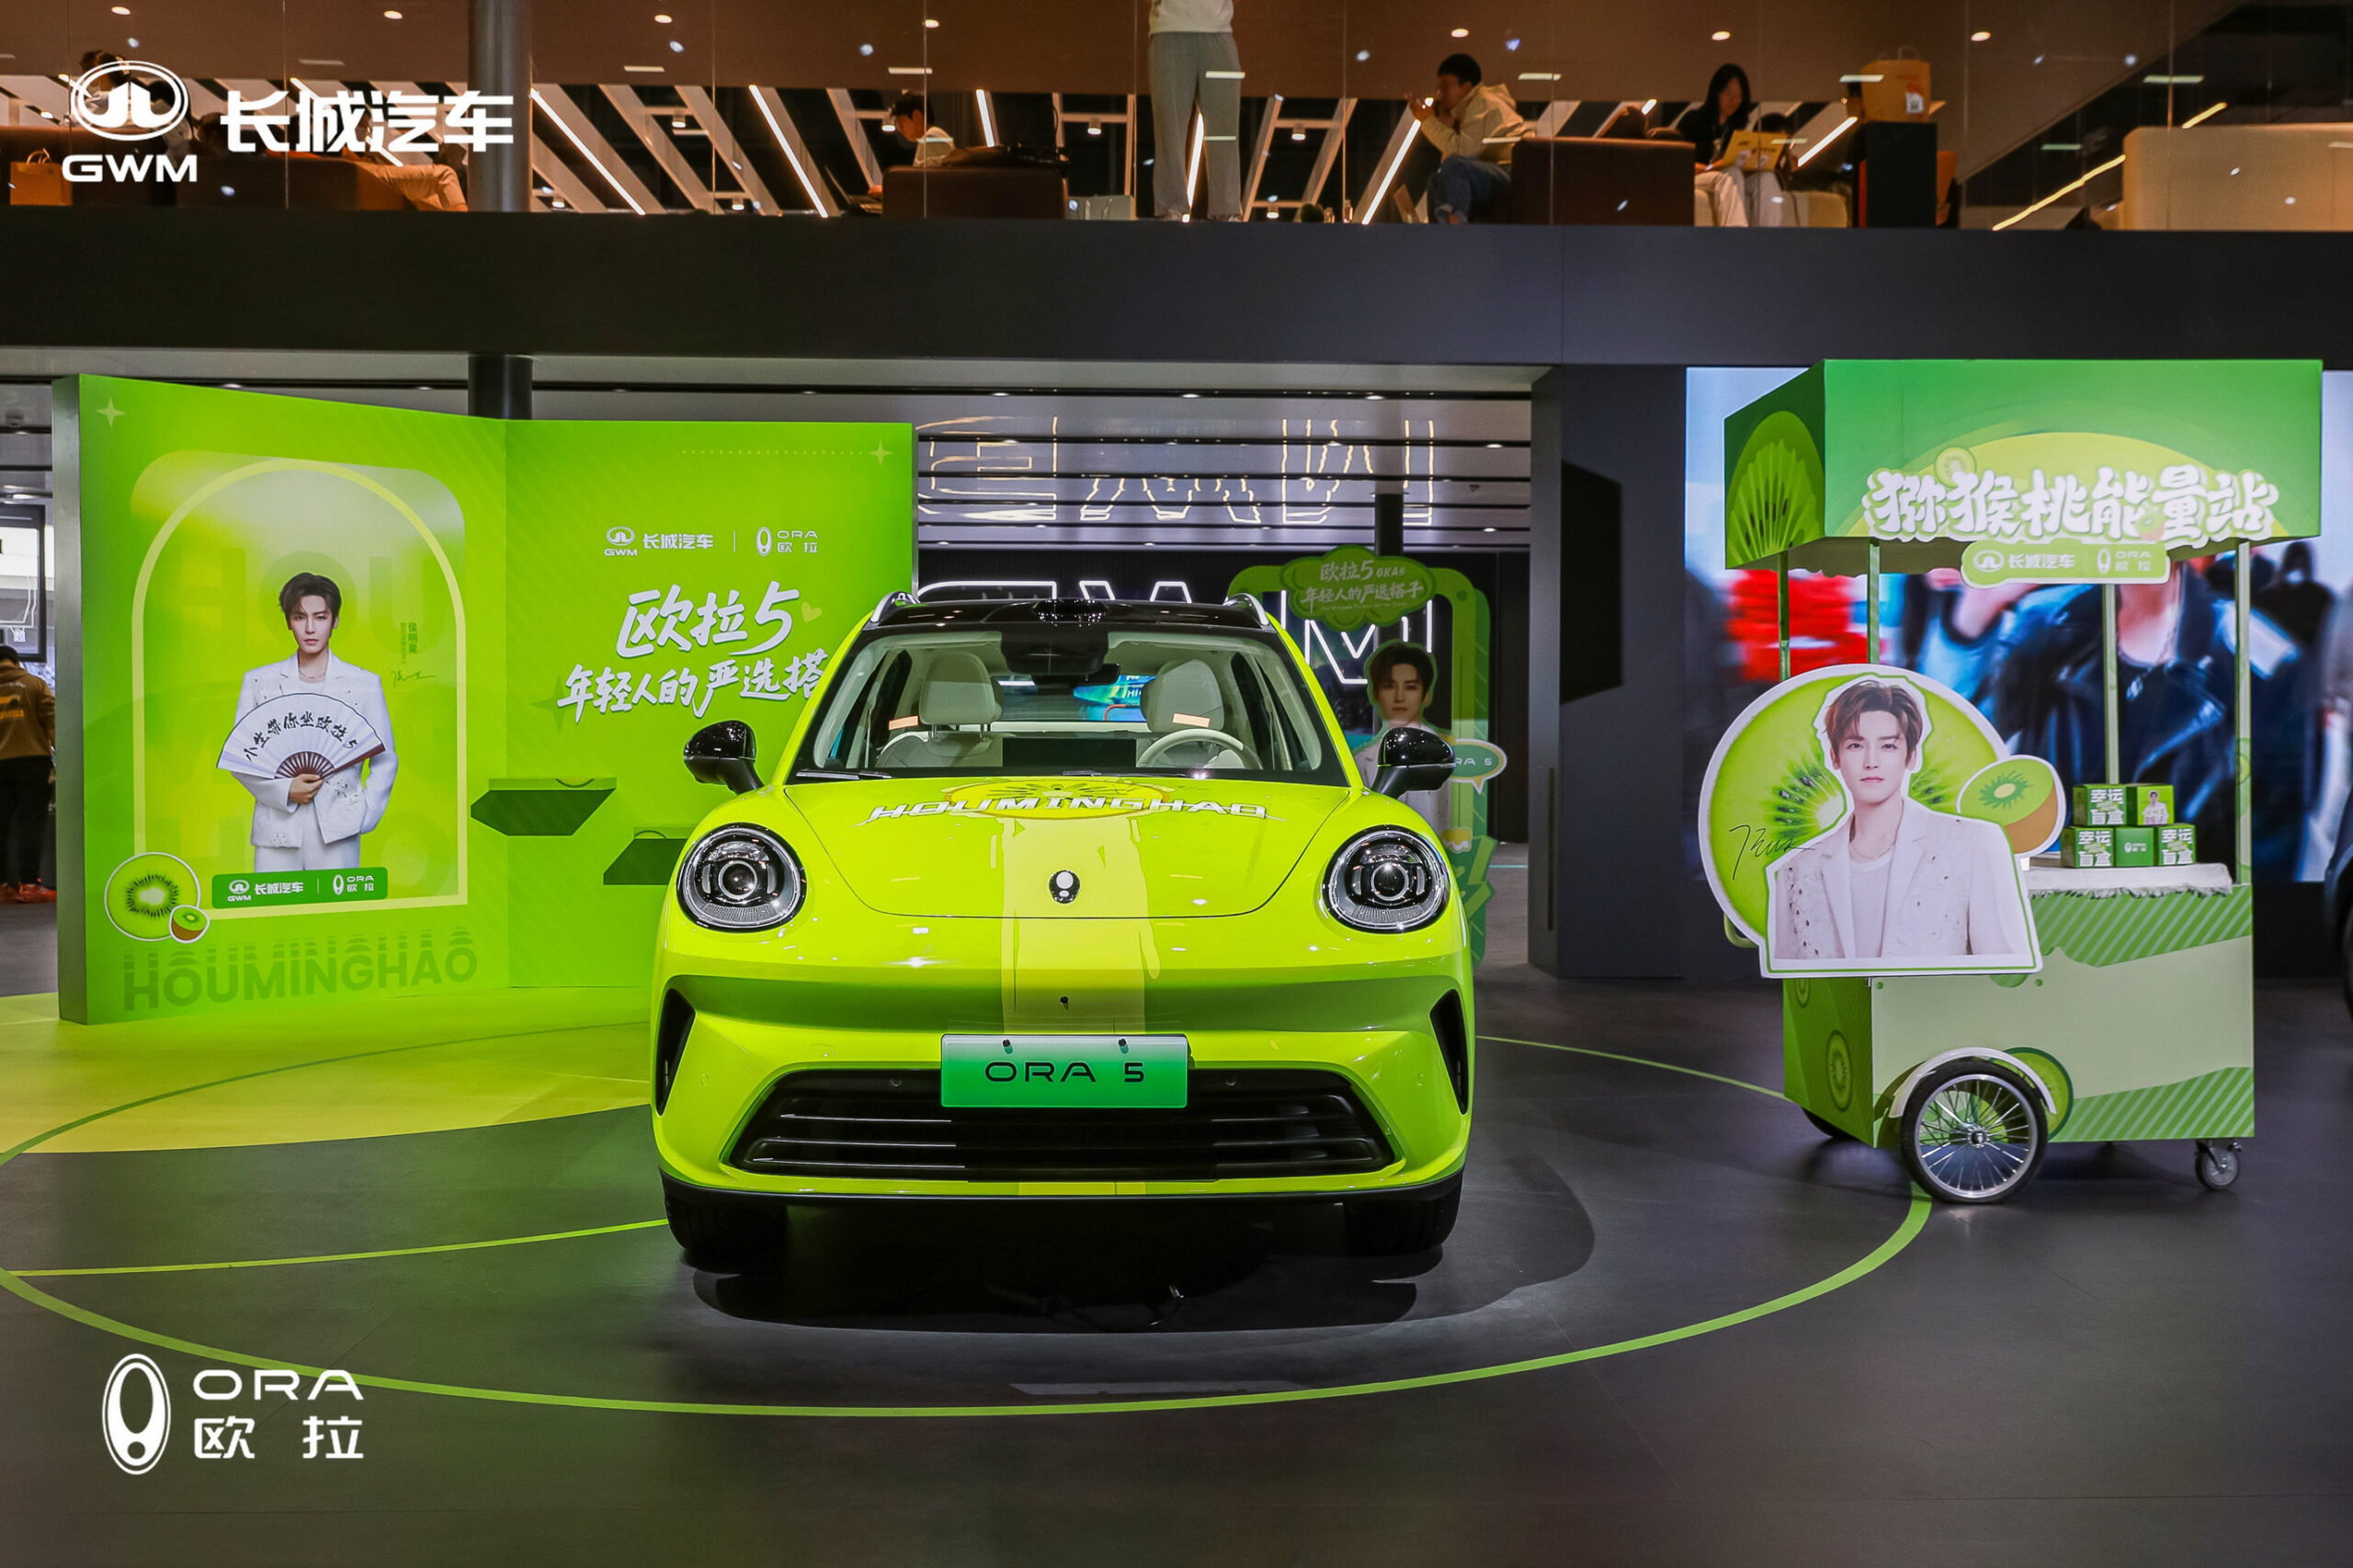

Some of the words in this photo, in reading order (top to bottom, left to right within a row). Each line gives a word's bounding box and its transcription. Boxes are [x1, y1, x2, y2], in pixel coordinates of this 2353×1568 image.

[643, 532, 714, 550] 长城汽车
[778, 530, 818, 540] ORA
[604, 548, 638, 556] GWM
[778, 542, 818, 553] 欧拉
[2115, 551, 2152, 559] ORA
[2008, 553, 2075, 570] 长城汽车
[1320, 559, 1375, 583] 欧拉5
[1301, 580, 1424, 613] 年轻人的严选搭子
[616, 580, 801, 658] 欧拉5
[1455, 757, 1476, 766] RA
[1484, 757, 1493, 767] 5
[865, 796, 1267, 822] HOUMINGHAO
[255, 881, 304, 895] 长城汽车
[347, 883, 375, 892] 欧拉
[123, 926, 478, 1012] HOUMINGHAO
[984, 1061, 1097, 1083] ORA
[1124, 1062, 1144, 1083] 5
